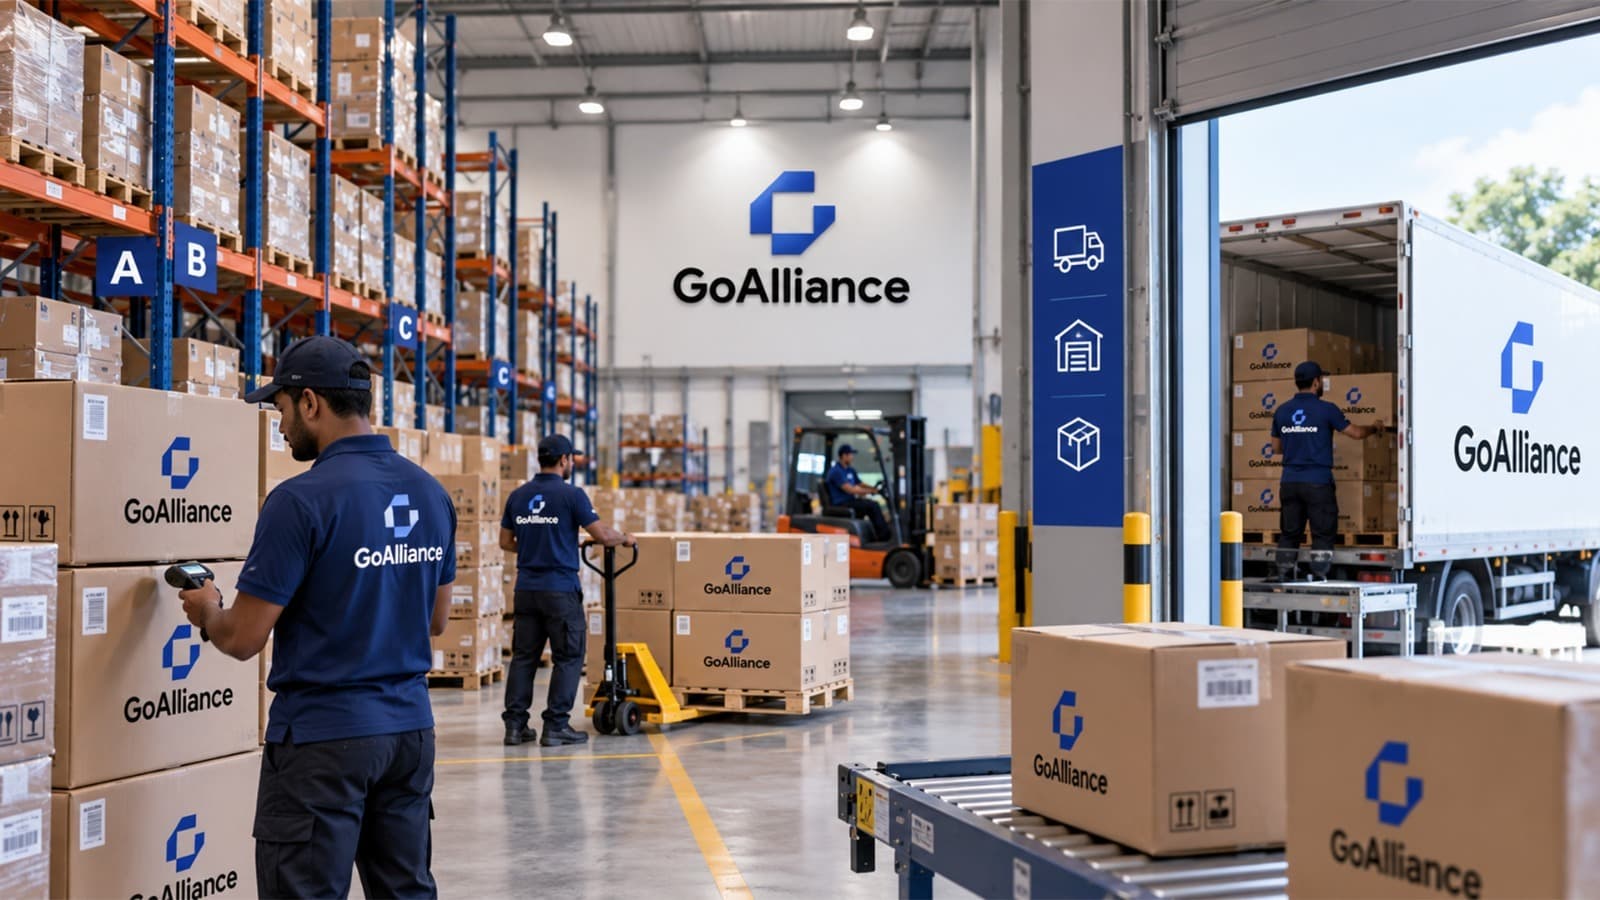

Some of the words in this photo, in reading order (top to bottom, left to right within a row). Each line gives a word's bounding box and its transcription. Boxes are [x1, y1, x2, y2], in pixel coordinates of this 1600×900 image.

[110, 250, 143, 285] A
[187, 242, 207, 278] B
[673, 266, 910, 304] GoAlliance
[399, 315, 413, 340] C
[498, 367, 509, 385] C
[1249, 361, 1292, 371] GoAlliance
[1248, 411, 1274, 420] GoAlli
[1340, 406, 1376, 414] oAlliance
[1281, 425, 1318, 434] GoAlliance
[1454, 425, 1581, 476] GoAlliance
[124, 497, 233, 524] GoAlliance
[515, 514, 559, 525] GoAlliance
[353, 545, 444, 569] GoAlliance
[703, 580, 773, 597] GoAlliance
[703, 655, 771, 671] GoAlliance
[123, 687, 234, 724] GoAlliance
[1033, 753, 1109, 795] GoAlliance
[1329, 828, 1482, 900] GoAlliance
[129, 870, 238, 900] Alliance
